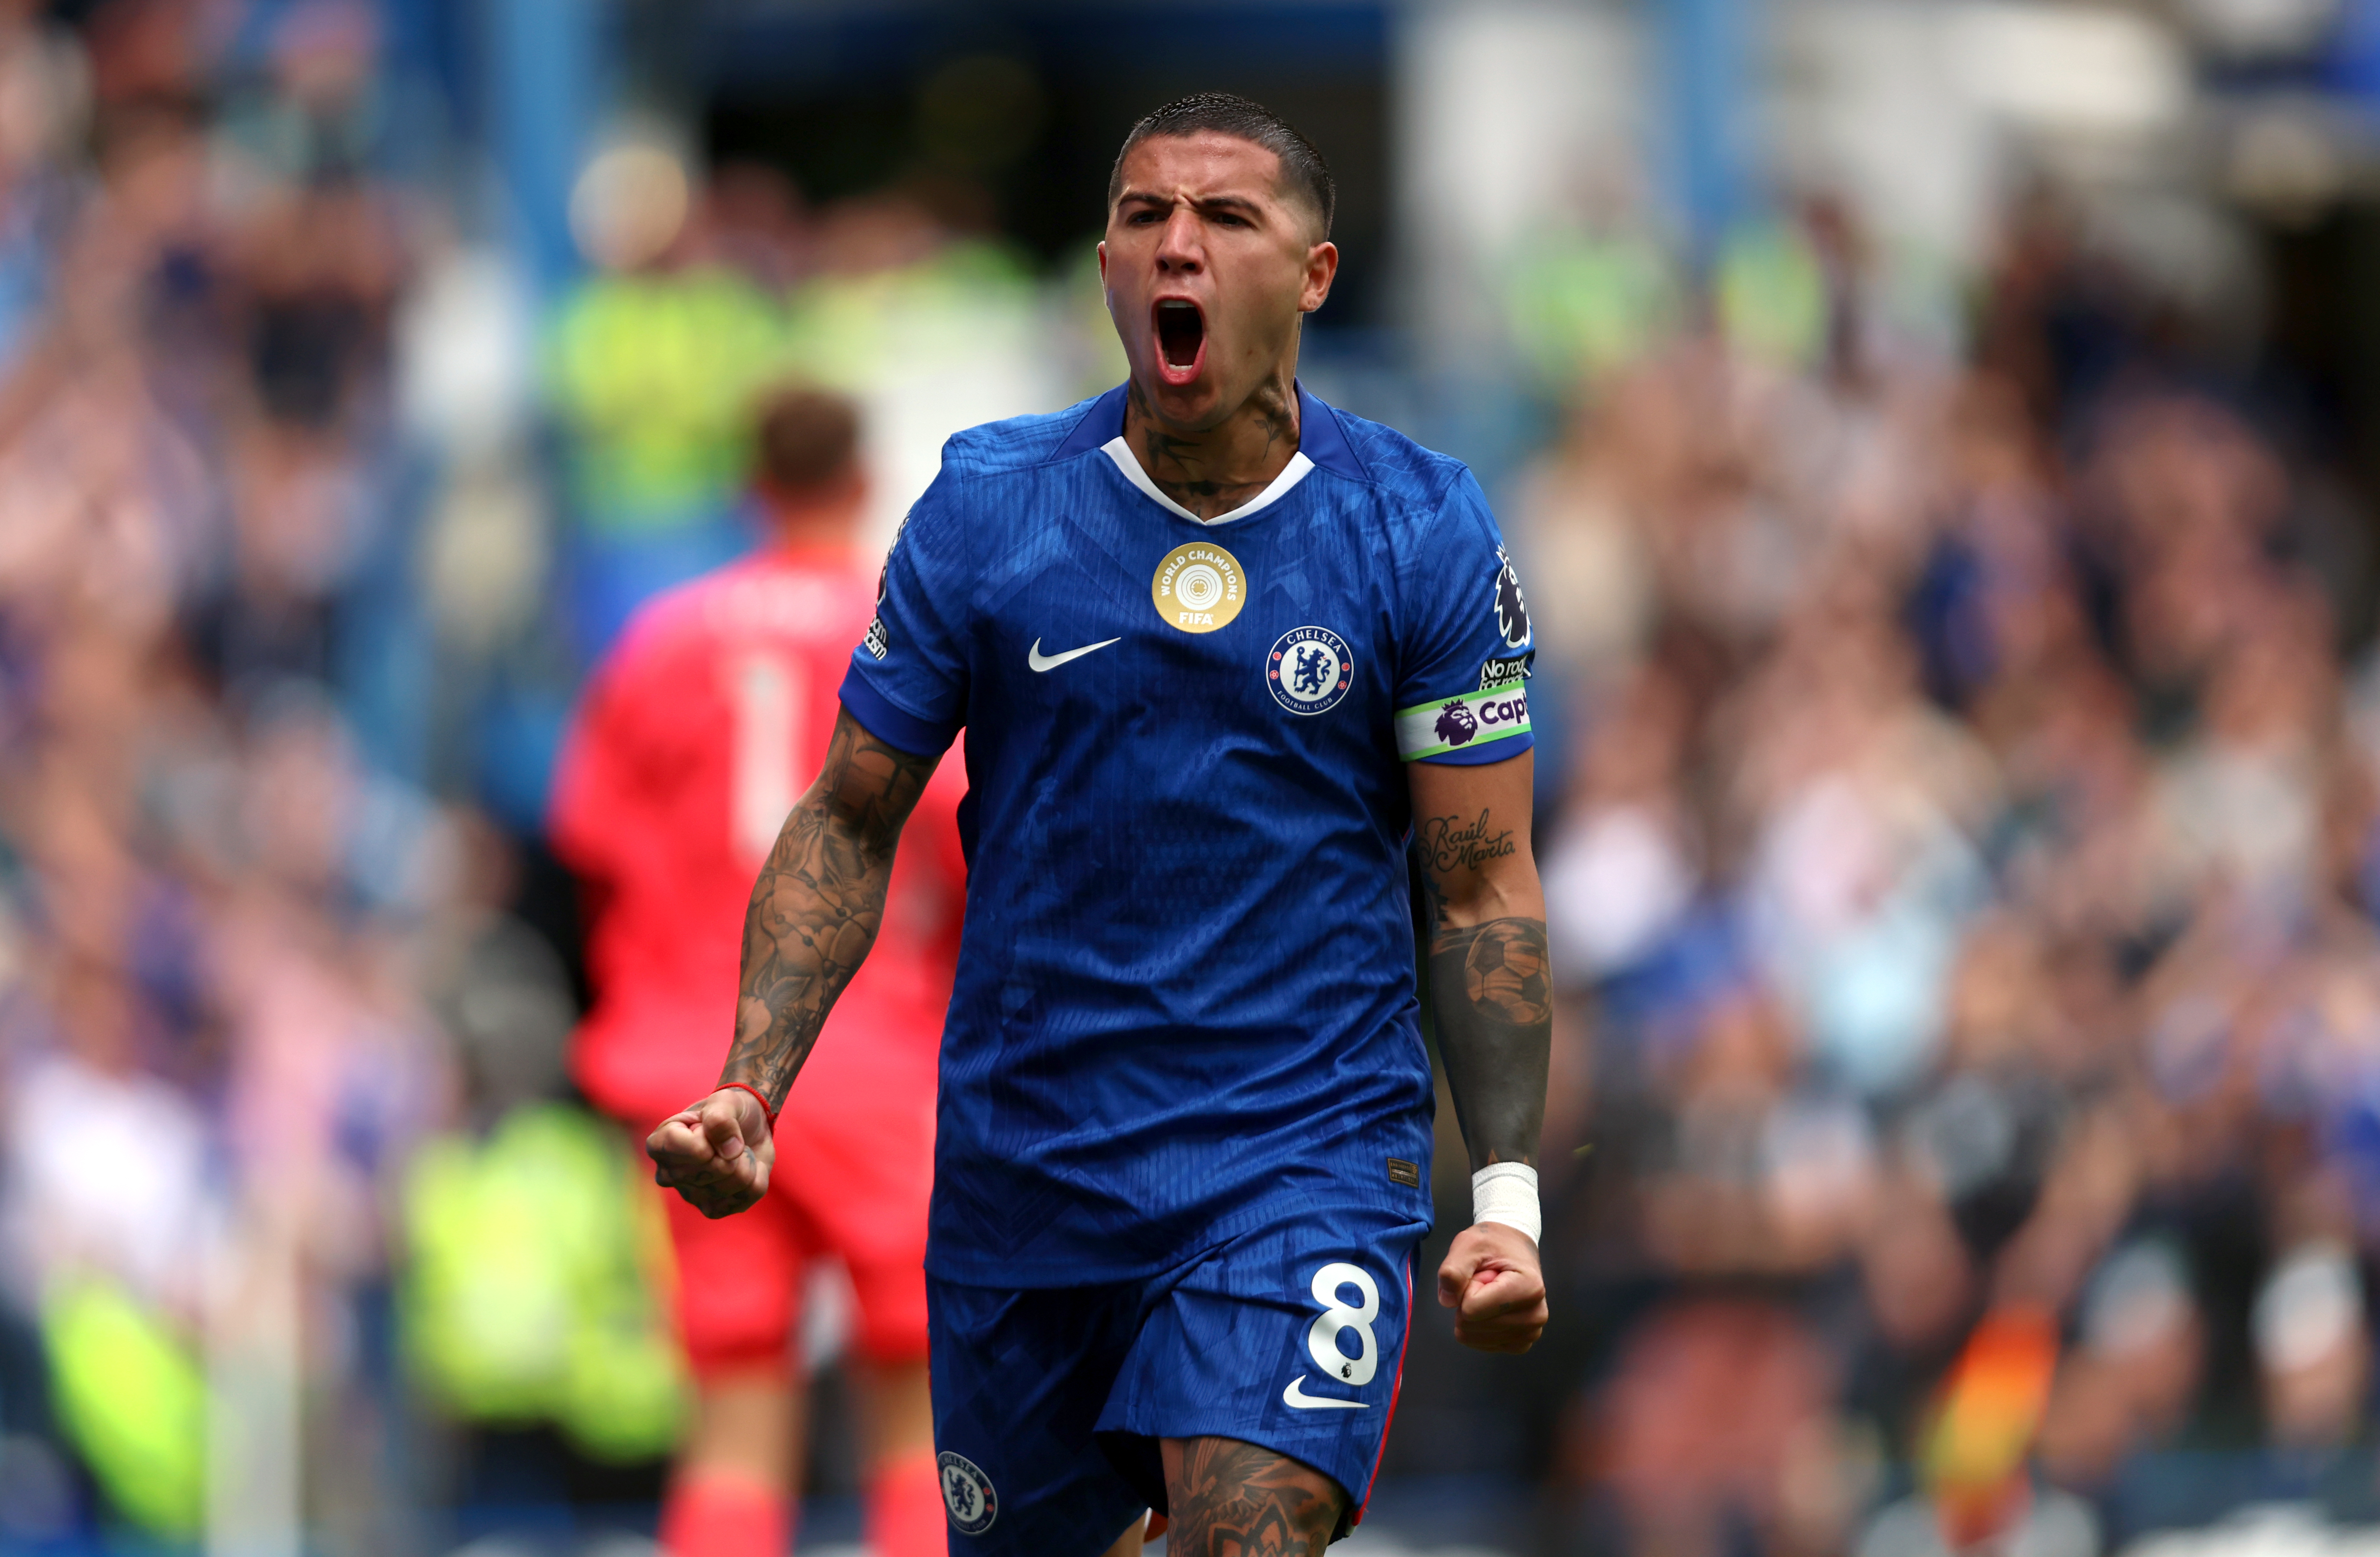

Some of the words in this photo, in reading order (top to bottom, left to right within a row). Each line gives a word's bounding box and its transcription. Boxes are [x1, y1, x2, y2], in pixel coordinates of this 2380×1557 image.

[1161, 556, 1186, 596] WORLD
[1188, 550, 1238, 600] CHAMPIONS
[1179, 612, 1213, 625] FIFA
[1287, 630, 1342, 652] CHELSEA
[1481, 659, 1505, 678] No
[1277, 691, 1310, 710] FOOTBALL
[1314, 697, 1333, 708] CLUB
[1308, 1262, 1380, 1386] 8
